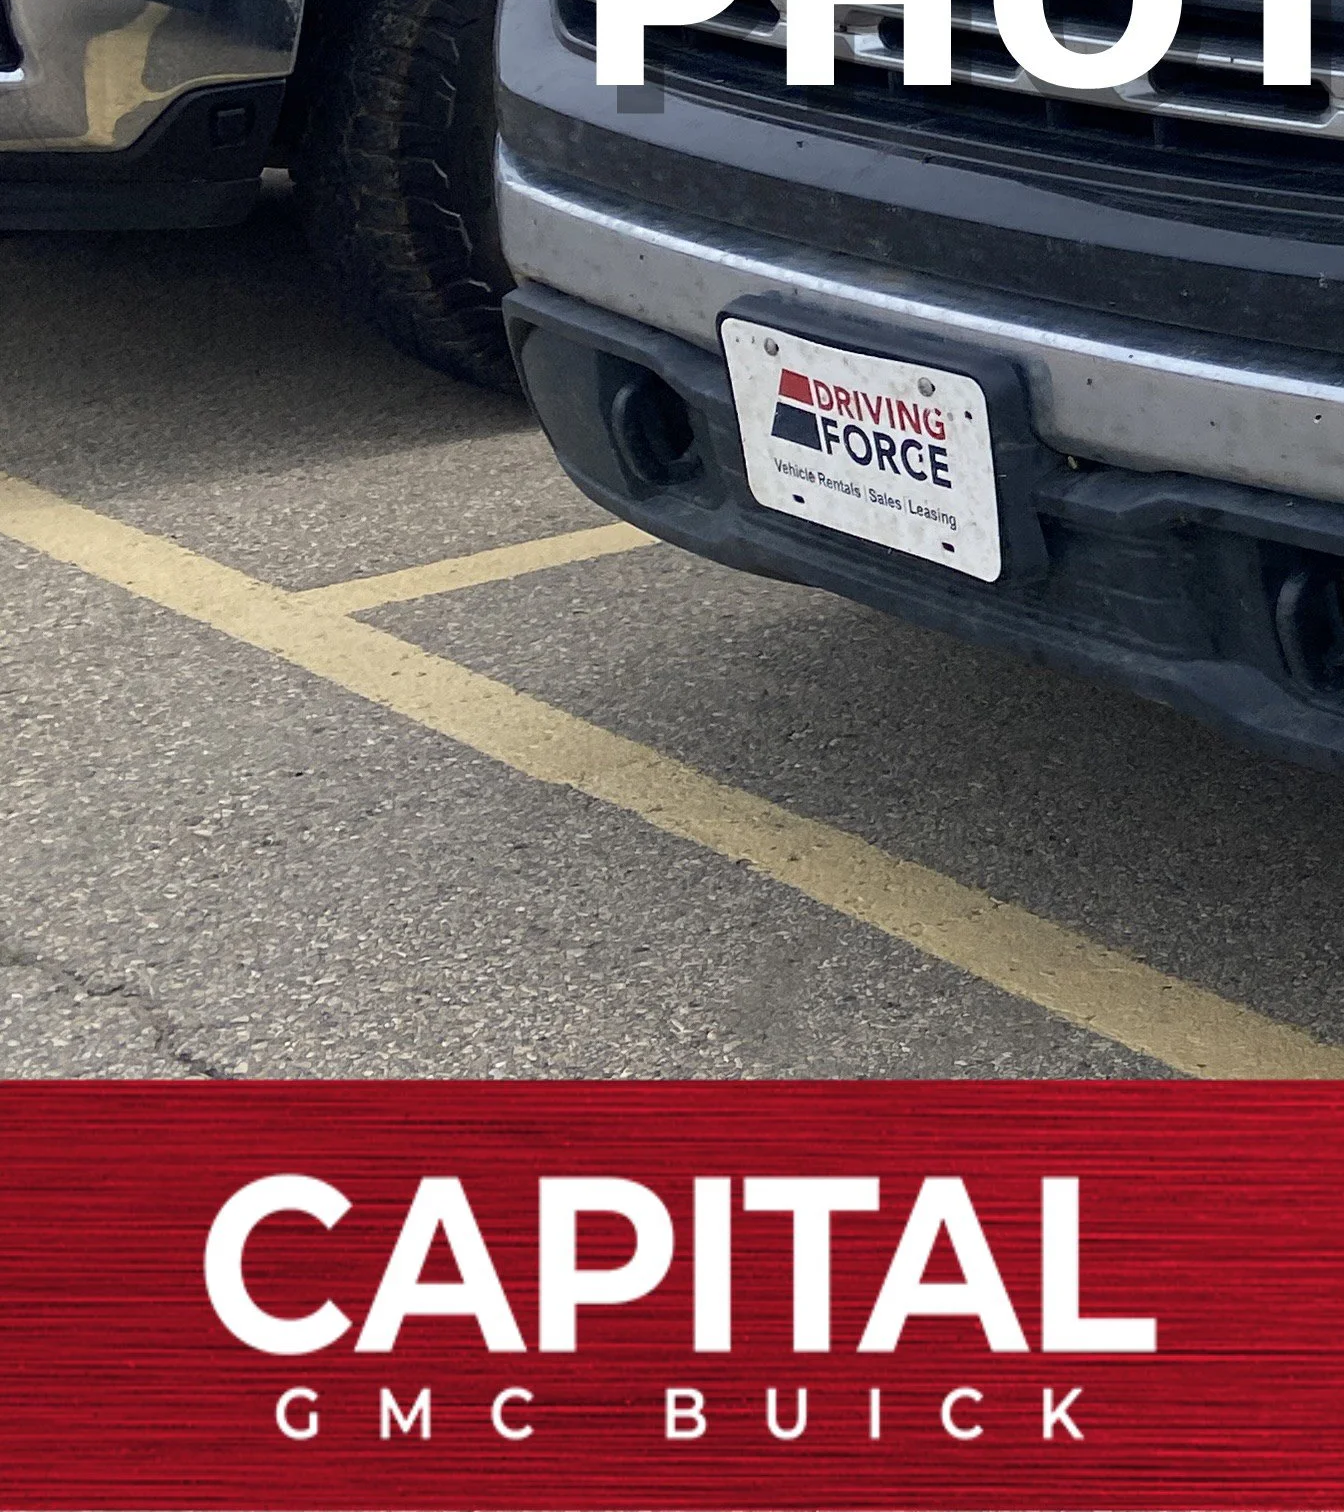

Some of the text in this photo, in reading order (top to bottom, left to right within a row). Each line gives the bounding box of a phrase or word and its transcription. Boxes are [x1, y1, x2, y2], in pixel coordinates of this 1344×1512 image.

[813, 379, 946, 440] DRIVING
[820, 416, 952, 489] FORCE
[774, 458, 957, 530] Vehicle Rentals Sales Leasing
